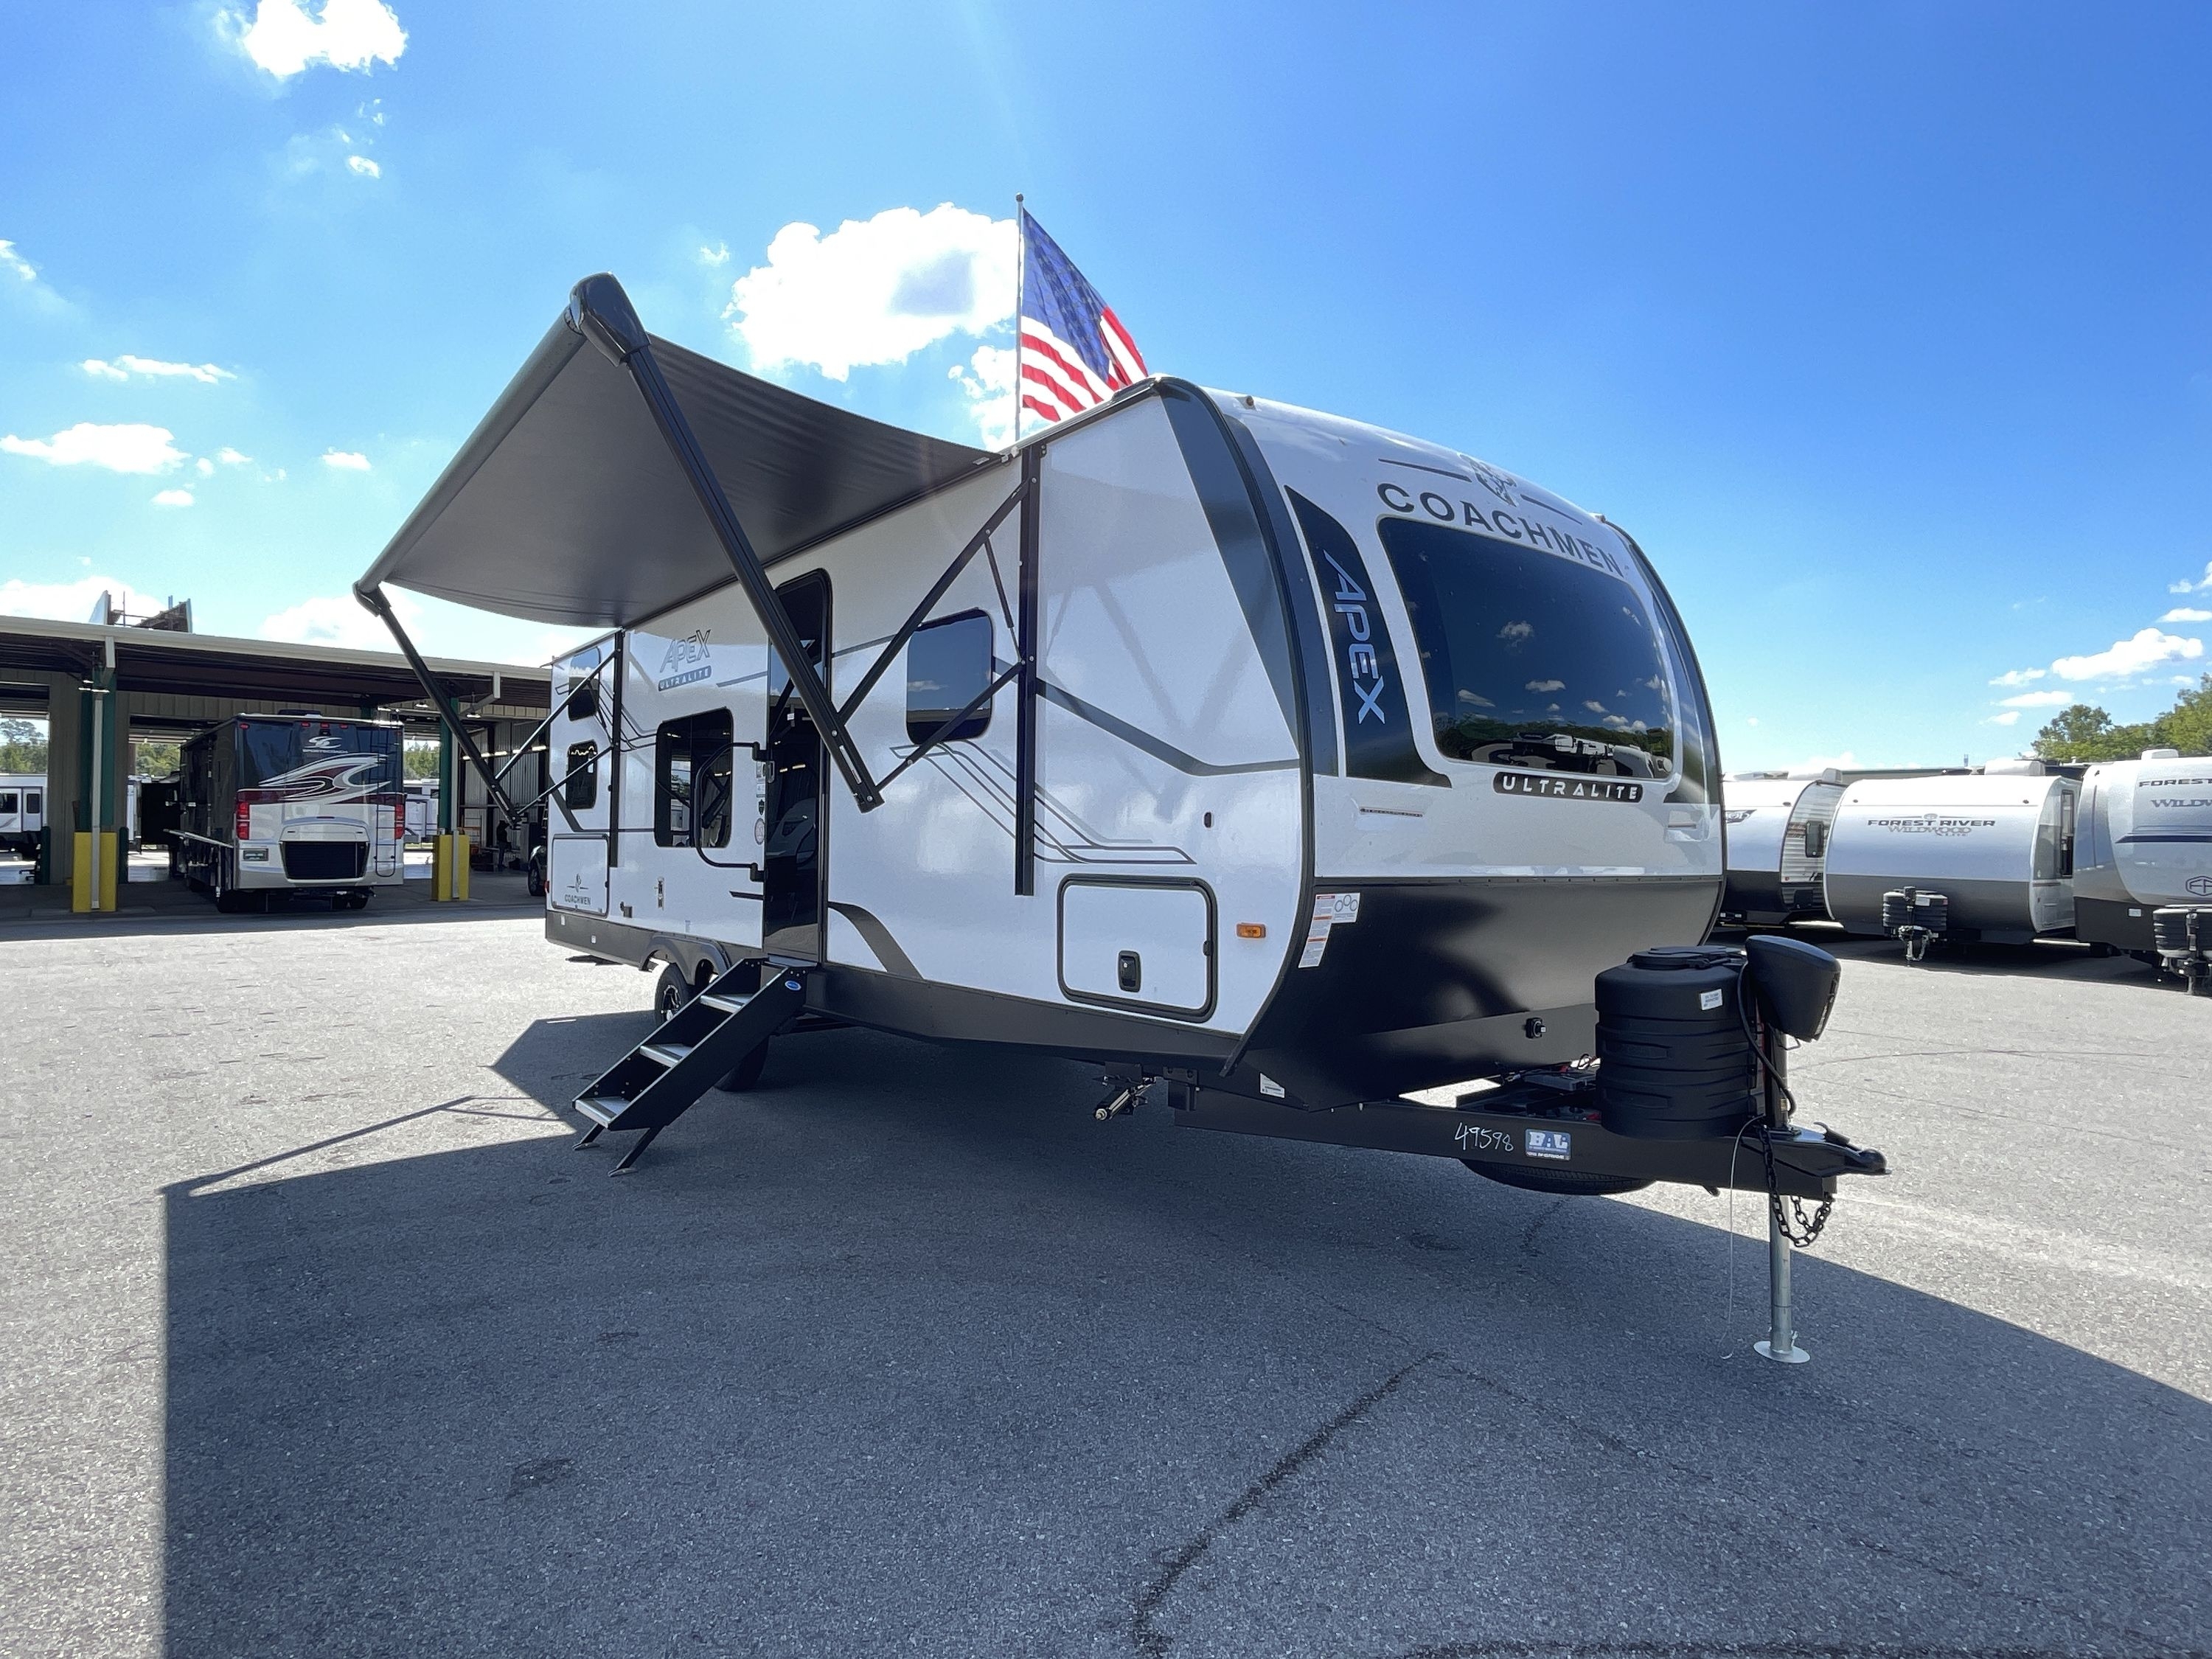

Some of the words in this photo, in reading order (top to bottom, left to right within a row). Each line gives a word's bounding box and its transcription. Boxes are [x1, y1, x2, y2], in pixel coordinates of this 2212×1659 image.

[1377, 482, 1624, 578] COACHMEN
[659, 628, 712, 673] APEX
[1323, 549, 1385, 725] APEX
[1502, 775, 1638, 800] ULTRALITE
[1888, 826, 1972, 835] WILDWOOD
[1454, 1121, 1515, 1152] 49598
